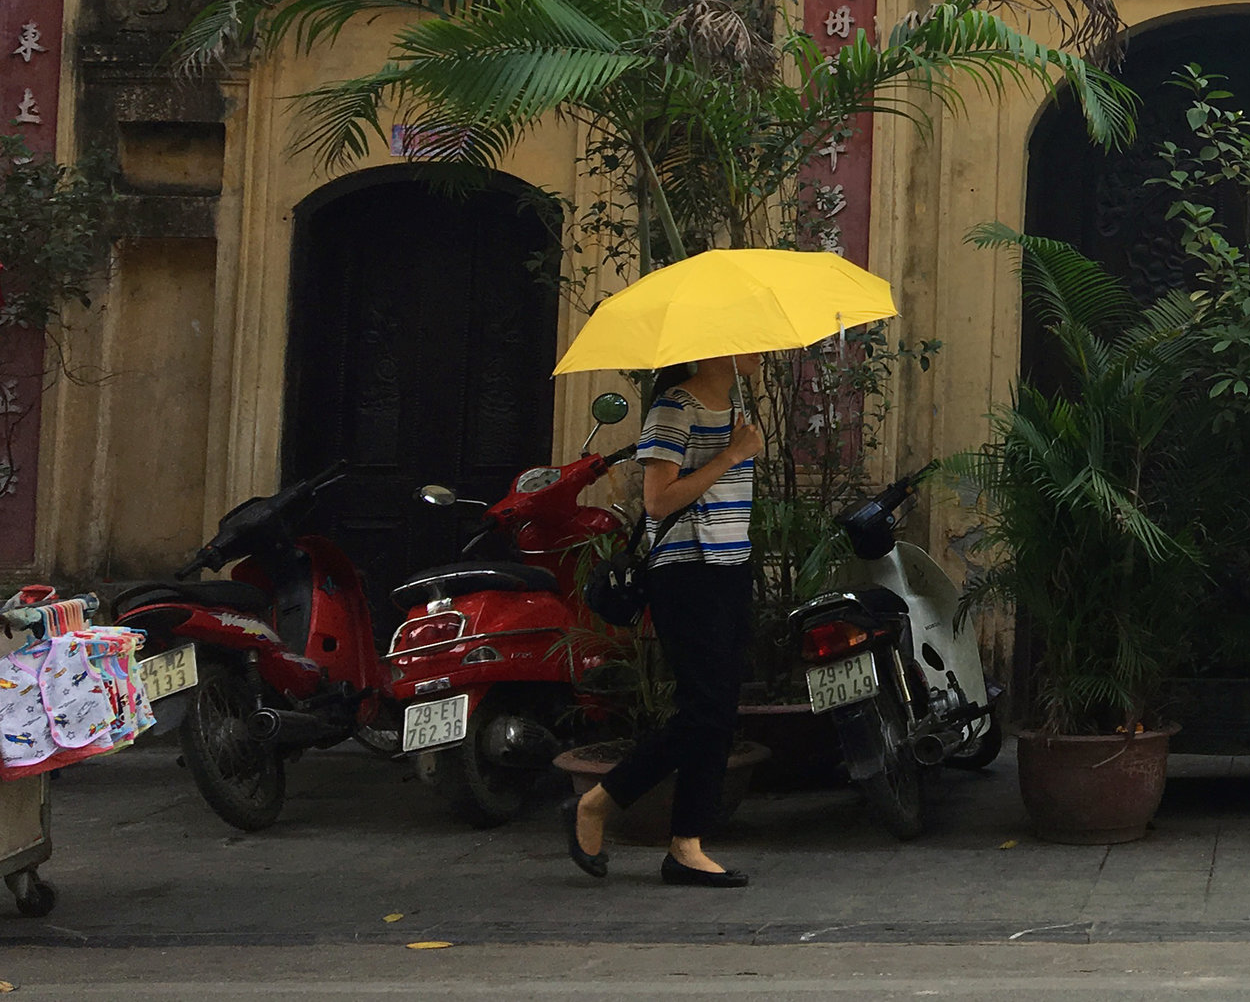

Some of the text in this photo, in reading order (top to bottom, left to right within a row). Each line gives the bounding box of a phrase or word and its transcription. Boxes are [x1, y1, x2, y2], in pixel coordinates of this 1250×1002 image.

[144, 669, 186, 697] 133
[817, 655, 864, 688] 29-P1
[815, 675, 874, 709] 320.49
[414, 700, 459, 727] 29-E1
[408, 719, 462, 747] 762.36
